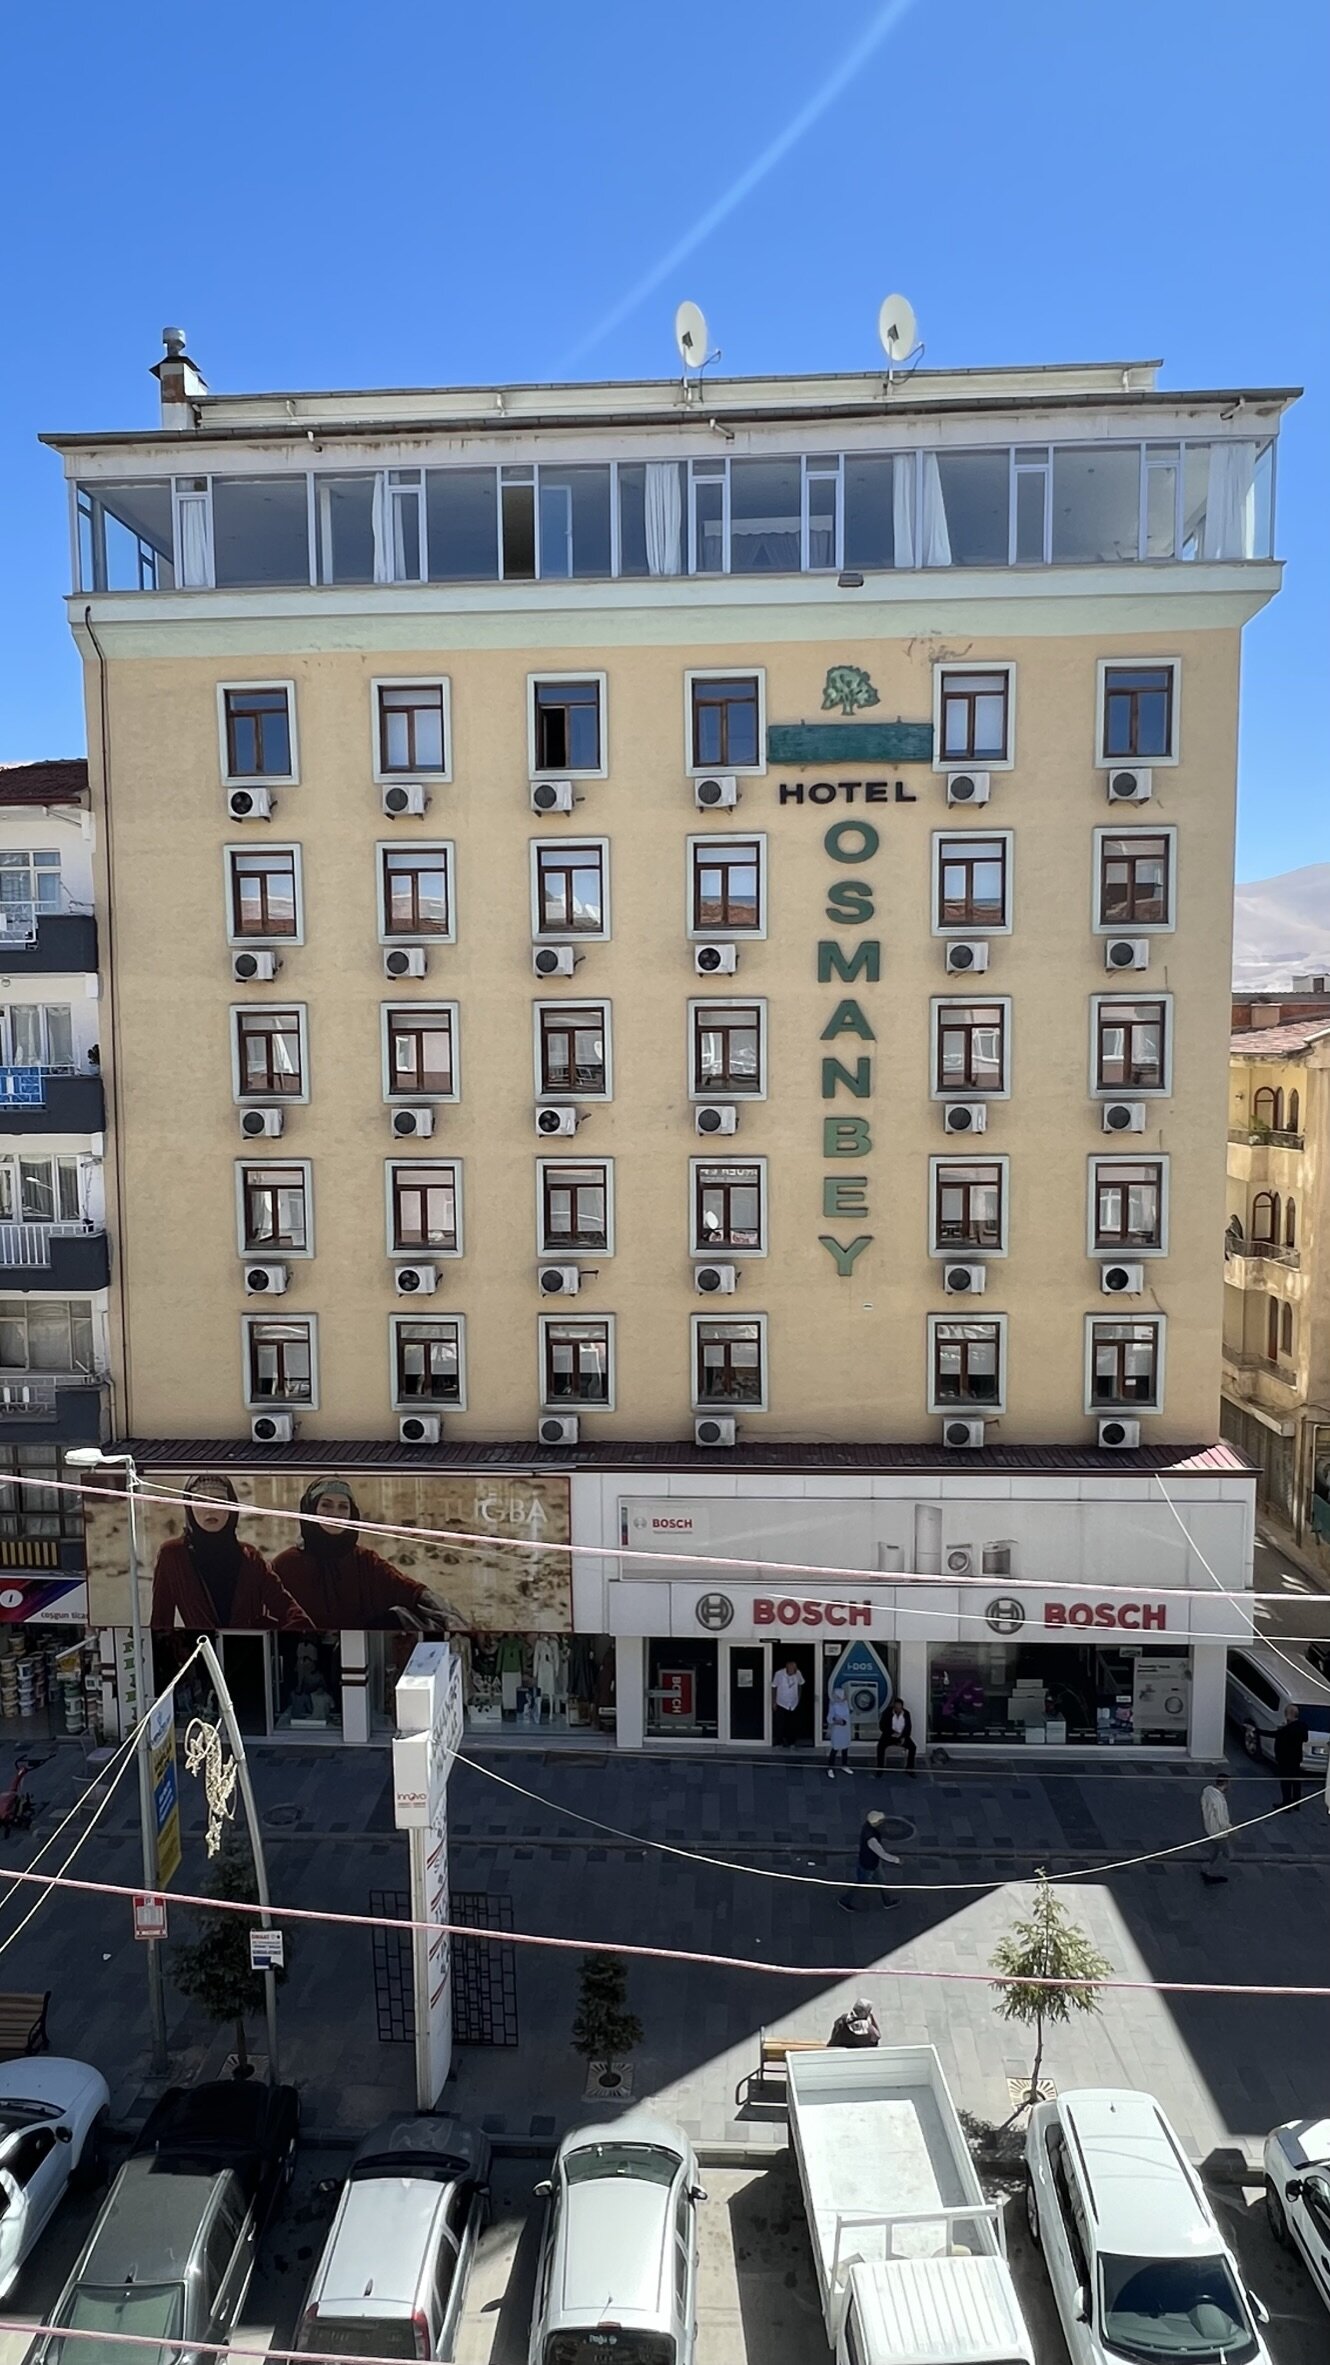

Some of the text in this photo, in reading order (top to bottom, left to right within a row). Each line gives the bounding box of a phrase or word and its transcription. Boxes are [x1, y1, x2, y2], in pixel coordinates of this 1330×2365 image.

[779, 781, 916, 805] HOTEL
[818, 820, 880, 1276] OSMANBEY
[652, 1518, 693, 1529] BOSCH
[752, 1598, 872, 1626] BOSCH
[1044, 1602, 1167, 1631] BOSCH
[671, 1676, 682, 1713] BOCH
